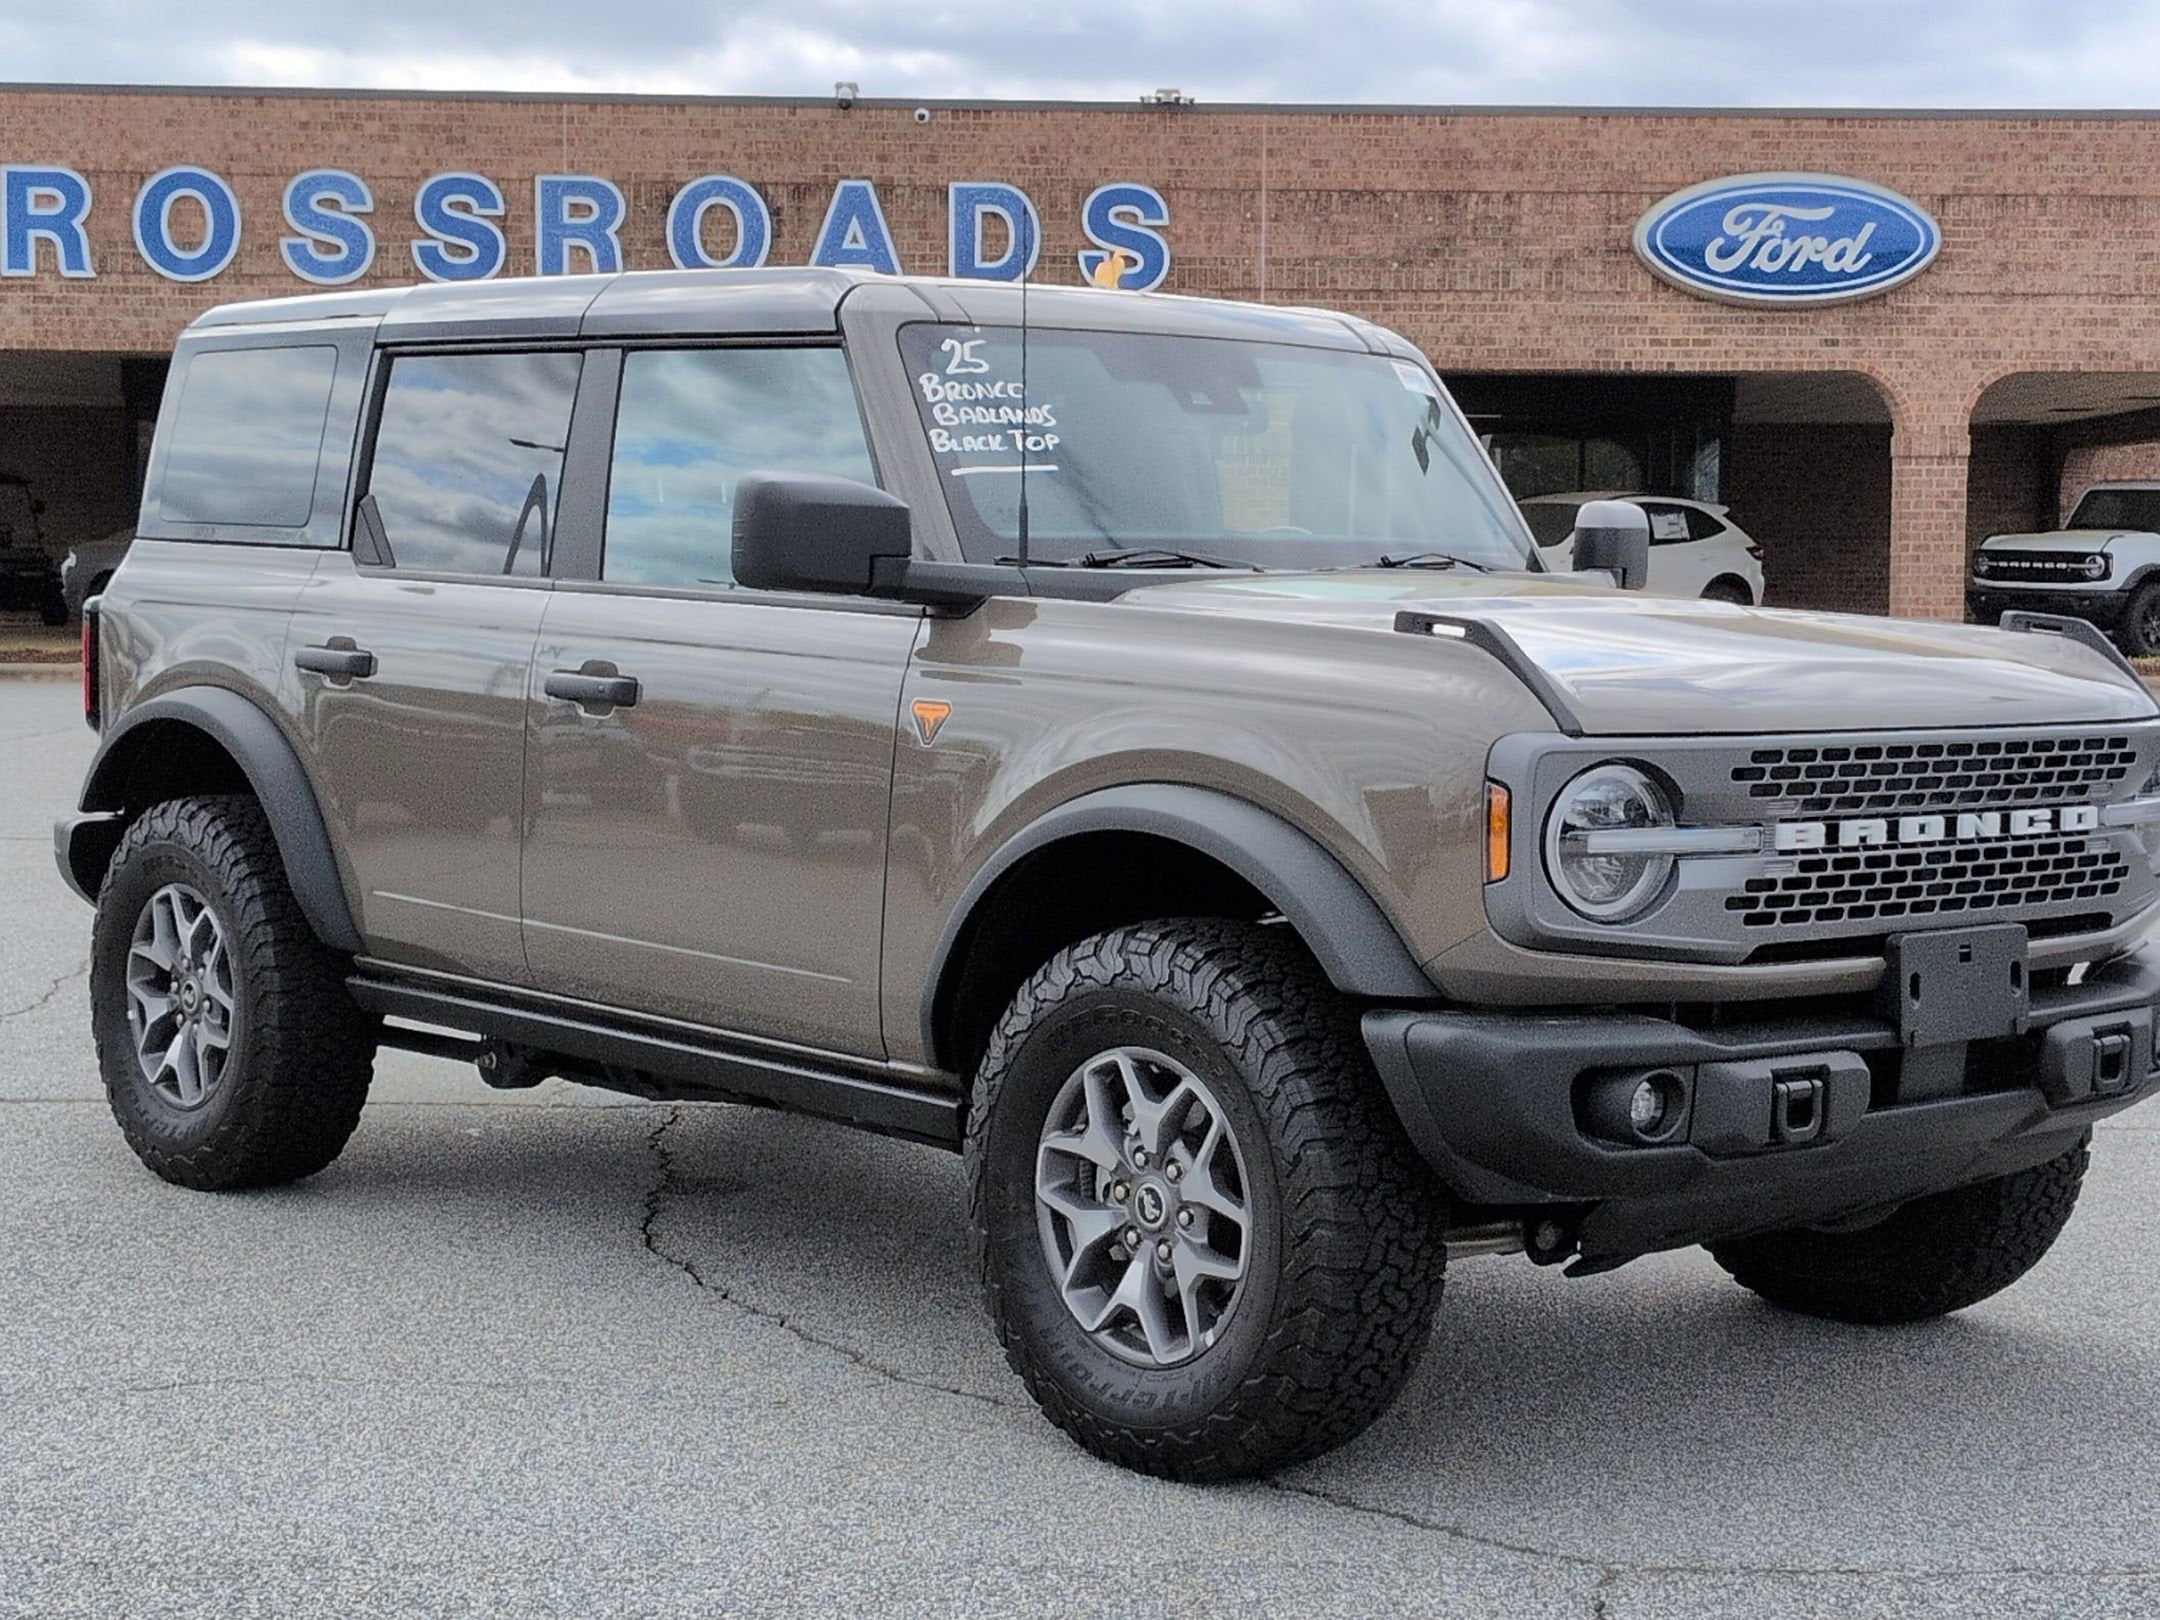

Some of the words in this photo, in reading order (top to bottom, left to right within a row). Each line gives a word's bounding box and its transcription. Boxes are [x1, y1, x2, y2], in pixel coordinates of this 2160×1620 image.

[1705, 202, 1877, 273] Ford
[940, 338, 990, 375] 25
[932, 402, 1057, 427] BADLANDS
[928, 428, 1009, 453] BLACK
[1006, 429, 1060, 452] TOP
[1774, 805, 2099, 851] BRONCO
